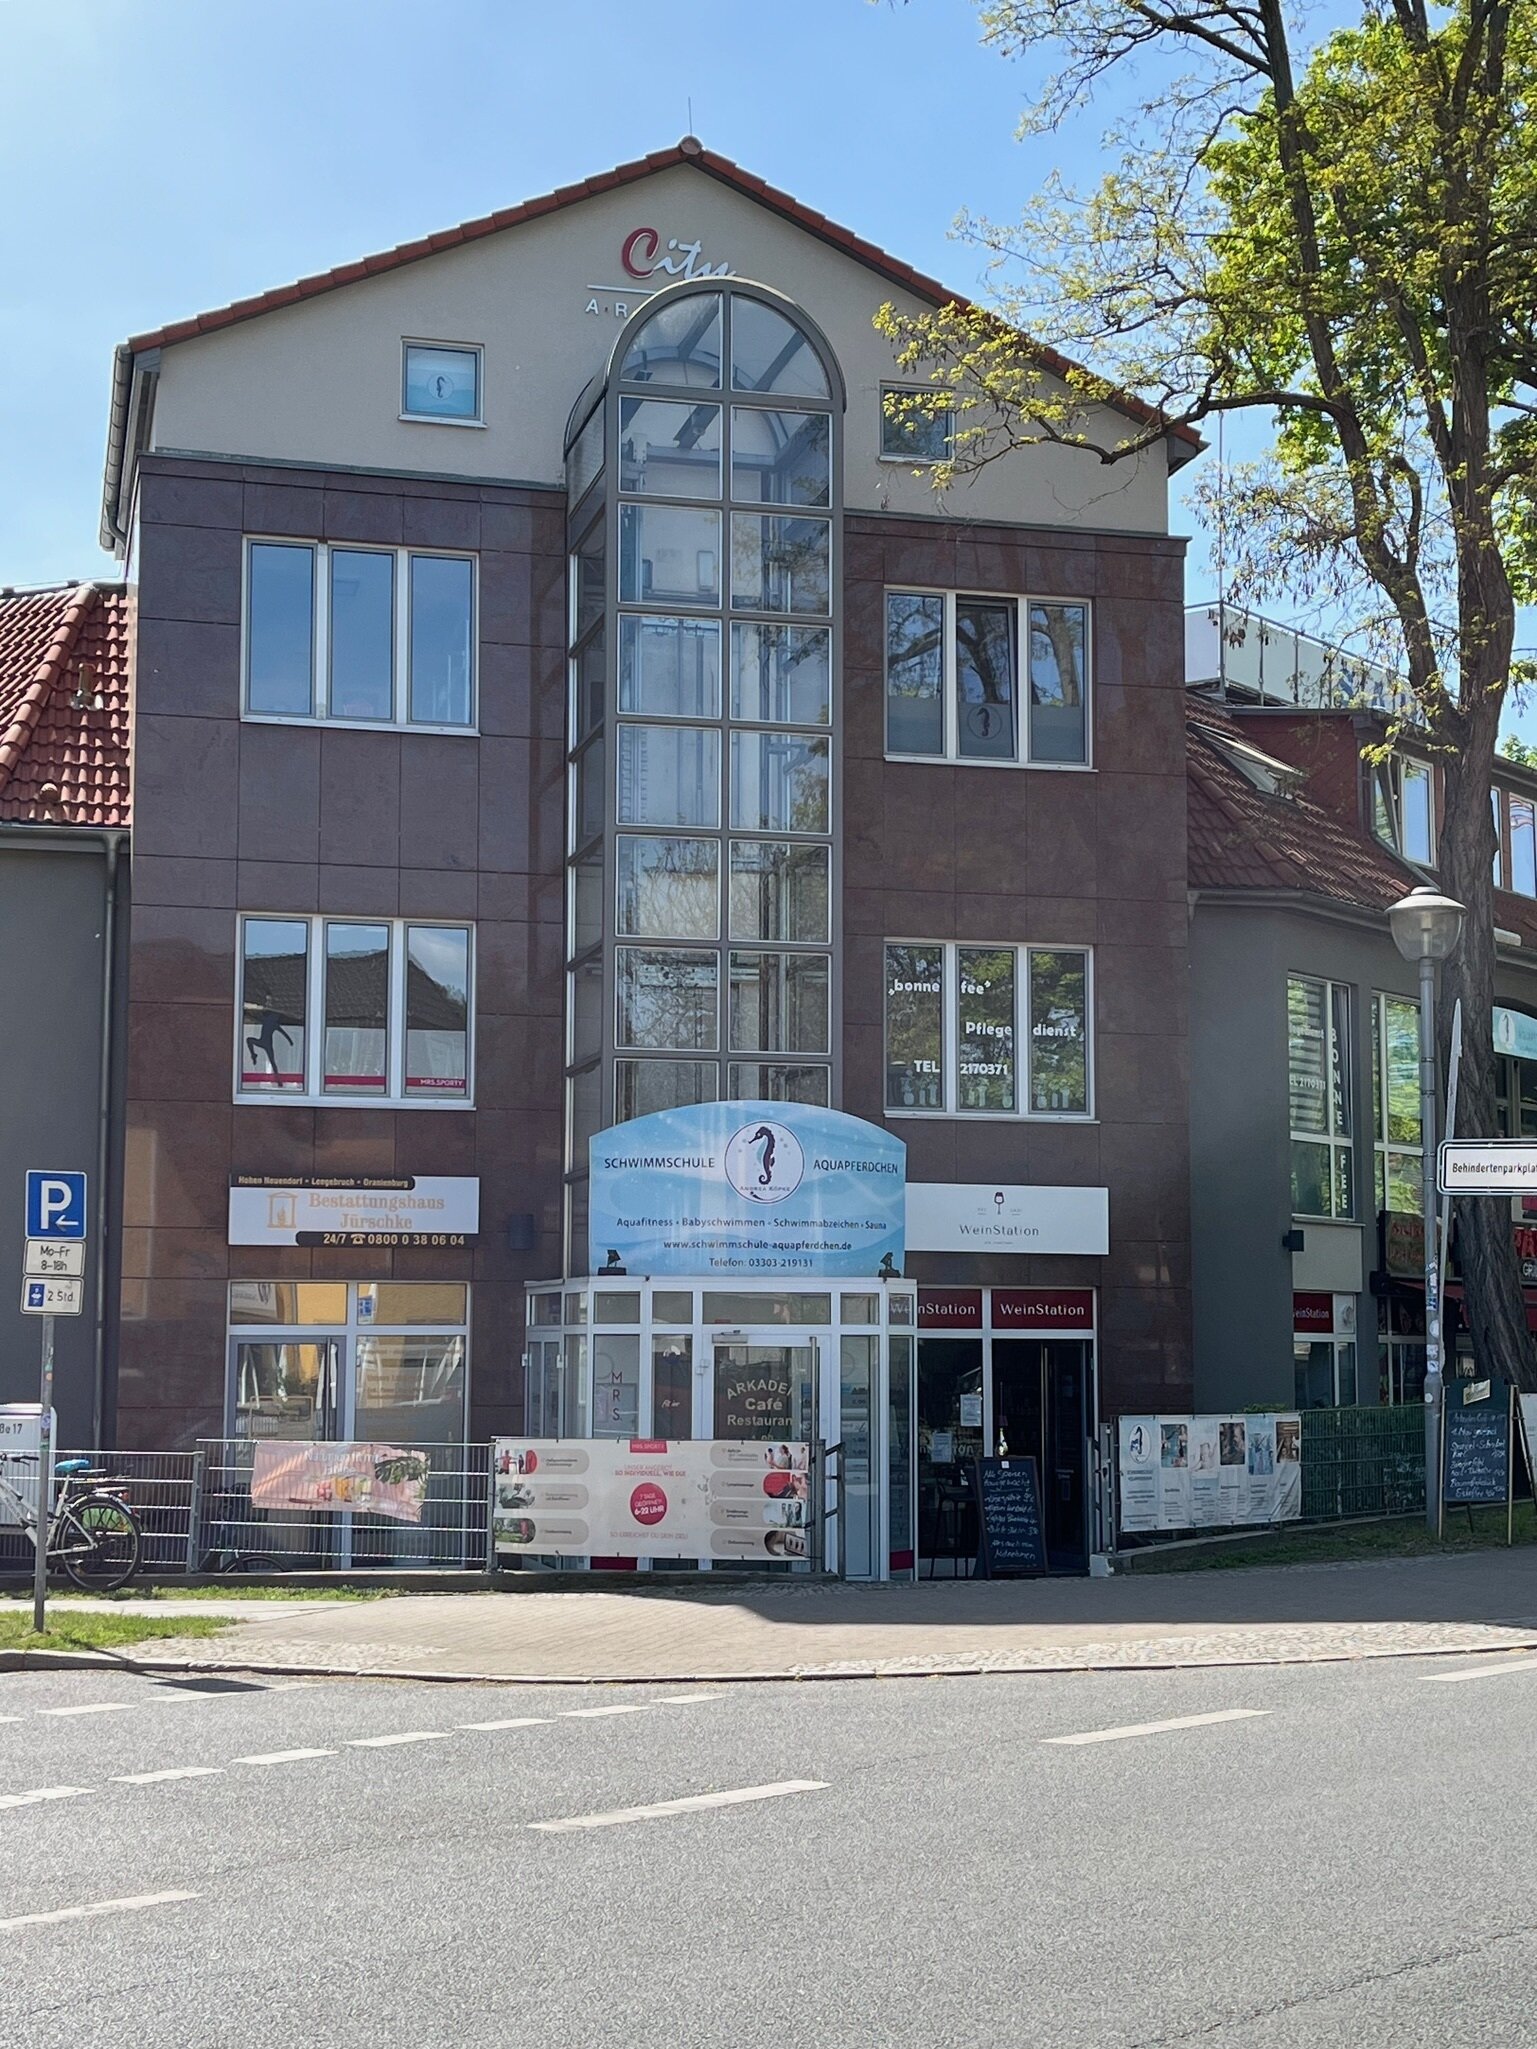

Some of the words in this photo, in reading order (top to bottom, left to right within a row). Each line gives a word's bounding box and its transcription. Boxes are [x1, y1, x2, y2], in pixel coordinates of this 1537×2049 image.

[965, 1021, 1013, 1039] Pflege
[1032, 1023, 1077, 1037] dienst
[914, 1059, 941, 1073] TEL
[959, 1063, 1009, 1075] 2170371
[603, 1156, 716, 1170] SCHWIMMSCHULE
[813, 1160, 899, 1175] AQUAPFERDCHEN
[1452, 1162, 1537, 1175] Behindertenparkpla
[363, 1177, 409, 1189] Oranienburg
[40, 1180, 73, 1230] P
[308, 1192, 446, 1212] Bestattungshaus
[339, 1212, 413, 1230] Jürschke
[616, 1217, 674, 1229] Aquafitness
[681, 1216, 766, 1229] Babyschwimmen
[773, 1217, 860, 1230] Schwimmabzeichen
[865, 1221, 888, 1231] Sauna
[959, 1224, 1040, 1237] WeinStation
[322, 1232, 347, 1245] 24/7
[367, 1233, 399, 1246] 0800
[401, 1234, 410, 1246] 0
[413, 1234, 428, 1246] 38
[431, 1234, 447, 1247] 06
[450, 1234, 466, 1247] 04
[663, 1239, 853, 1252] www.schwimmschule-aquapferdchen.de
[748, 1258, 814, 1269] 03303-219131
[47, 1290, 54, 1302] 2
[1000, 1302, 1086, 1317] WeinStation
[1292, 1306, 1330, 1319] einStation
[744, 1396, 783, 1412] Café
[12, 1422, 23, 1435] 17
